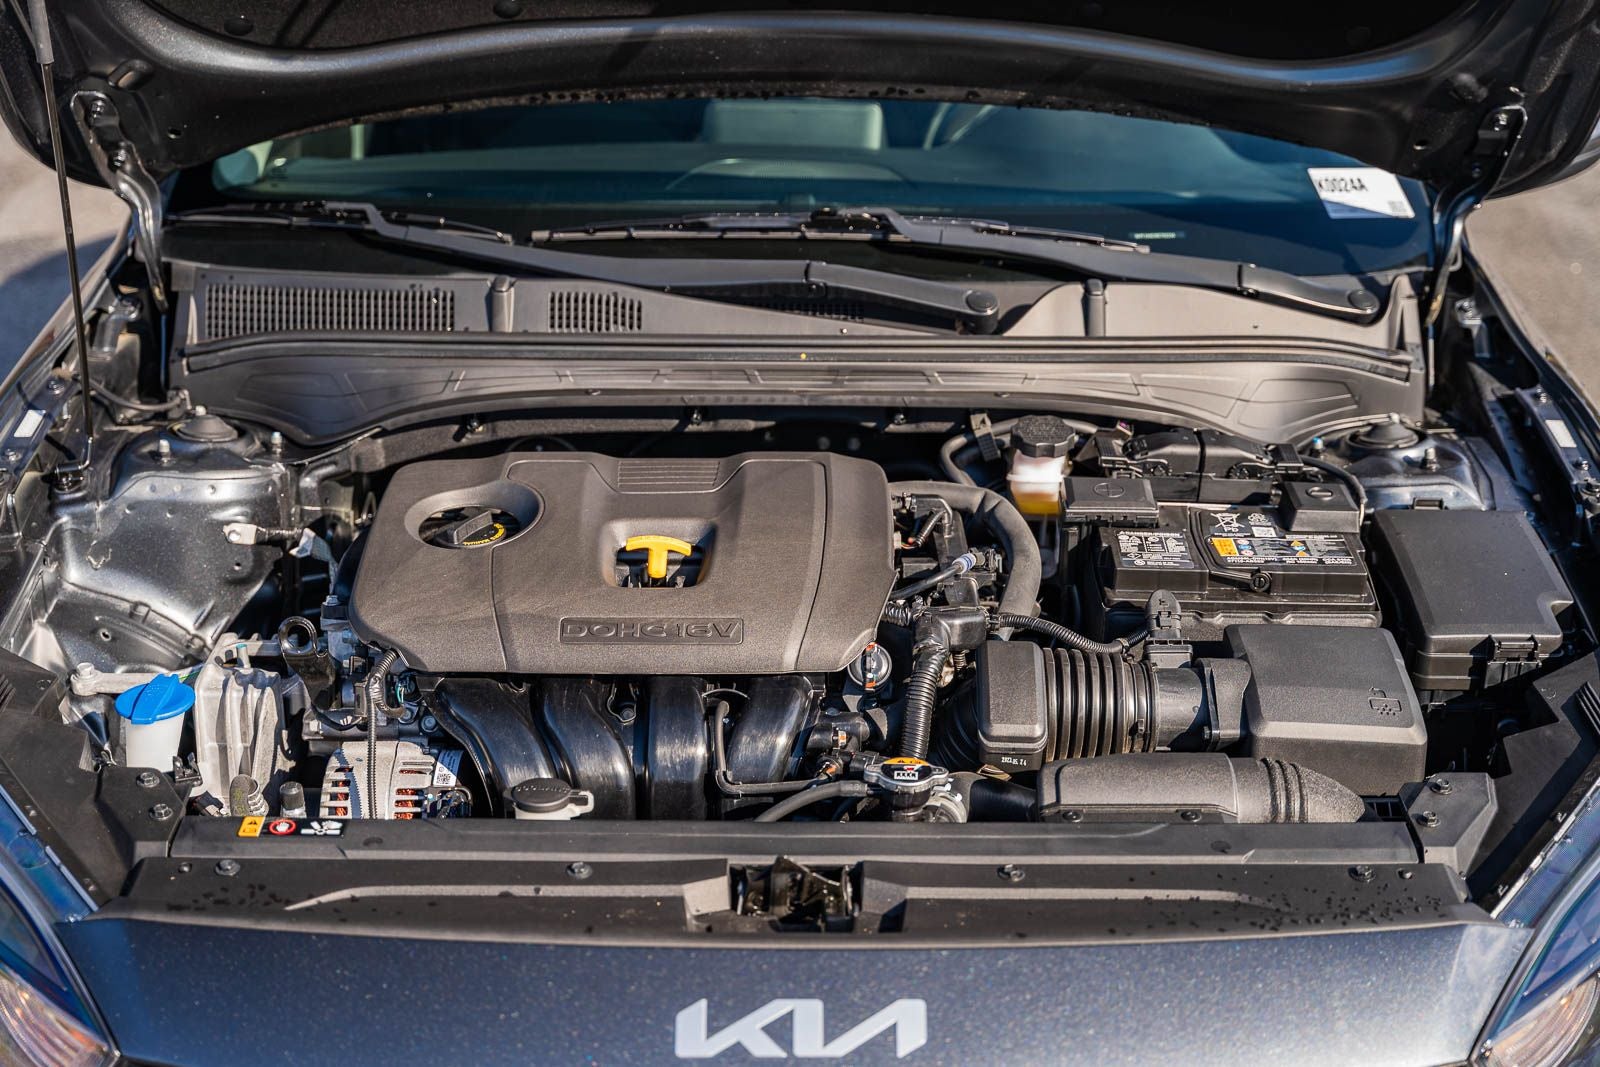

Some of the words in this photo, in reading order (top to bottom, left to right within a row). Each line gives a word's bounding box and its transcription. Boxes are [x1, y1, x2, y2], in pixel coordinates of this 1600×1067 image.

[562, 622, 667, 638] DOHC
[676, 622, 740, 639] 16V
[675, 998, 928, 1058] KIA
